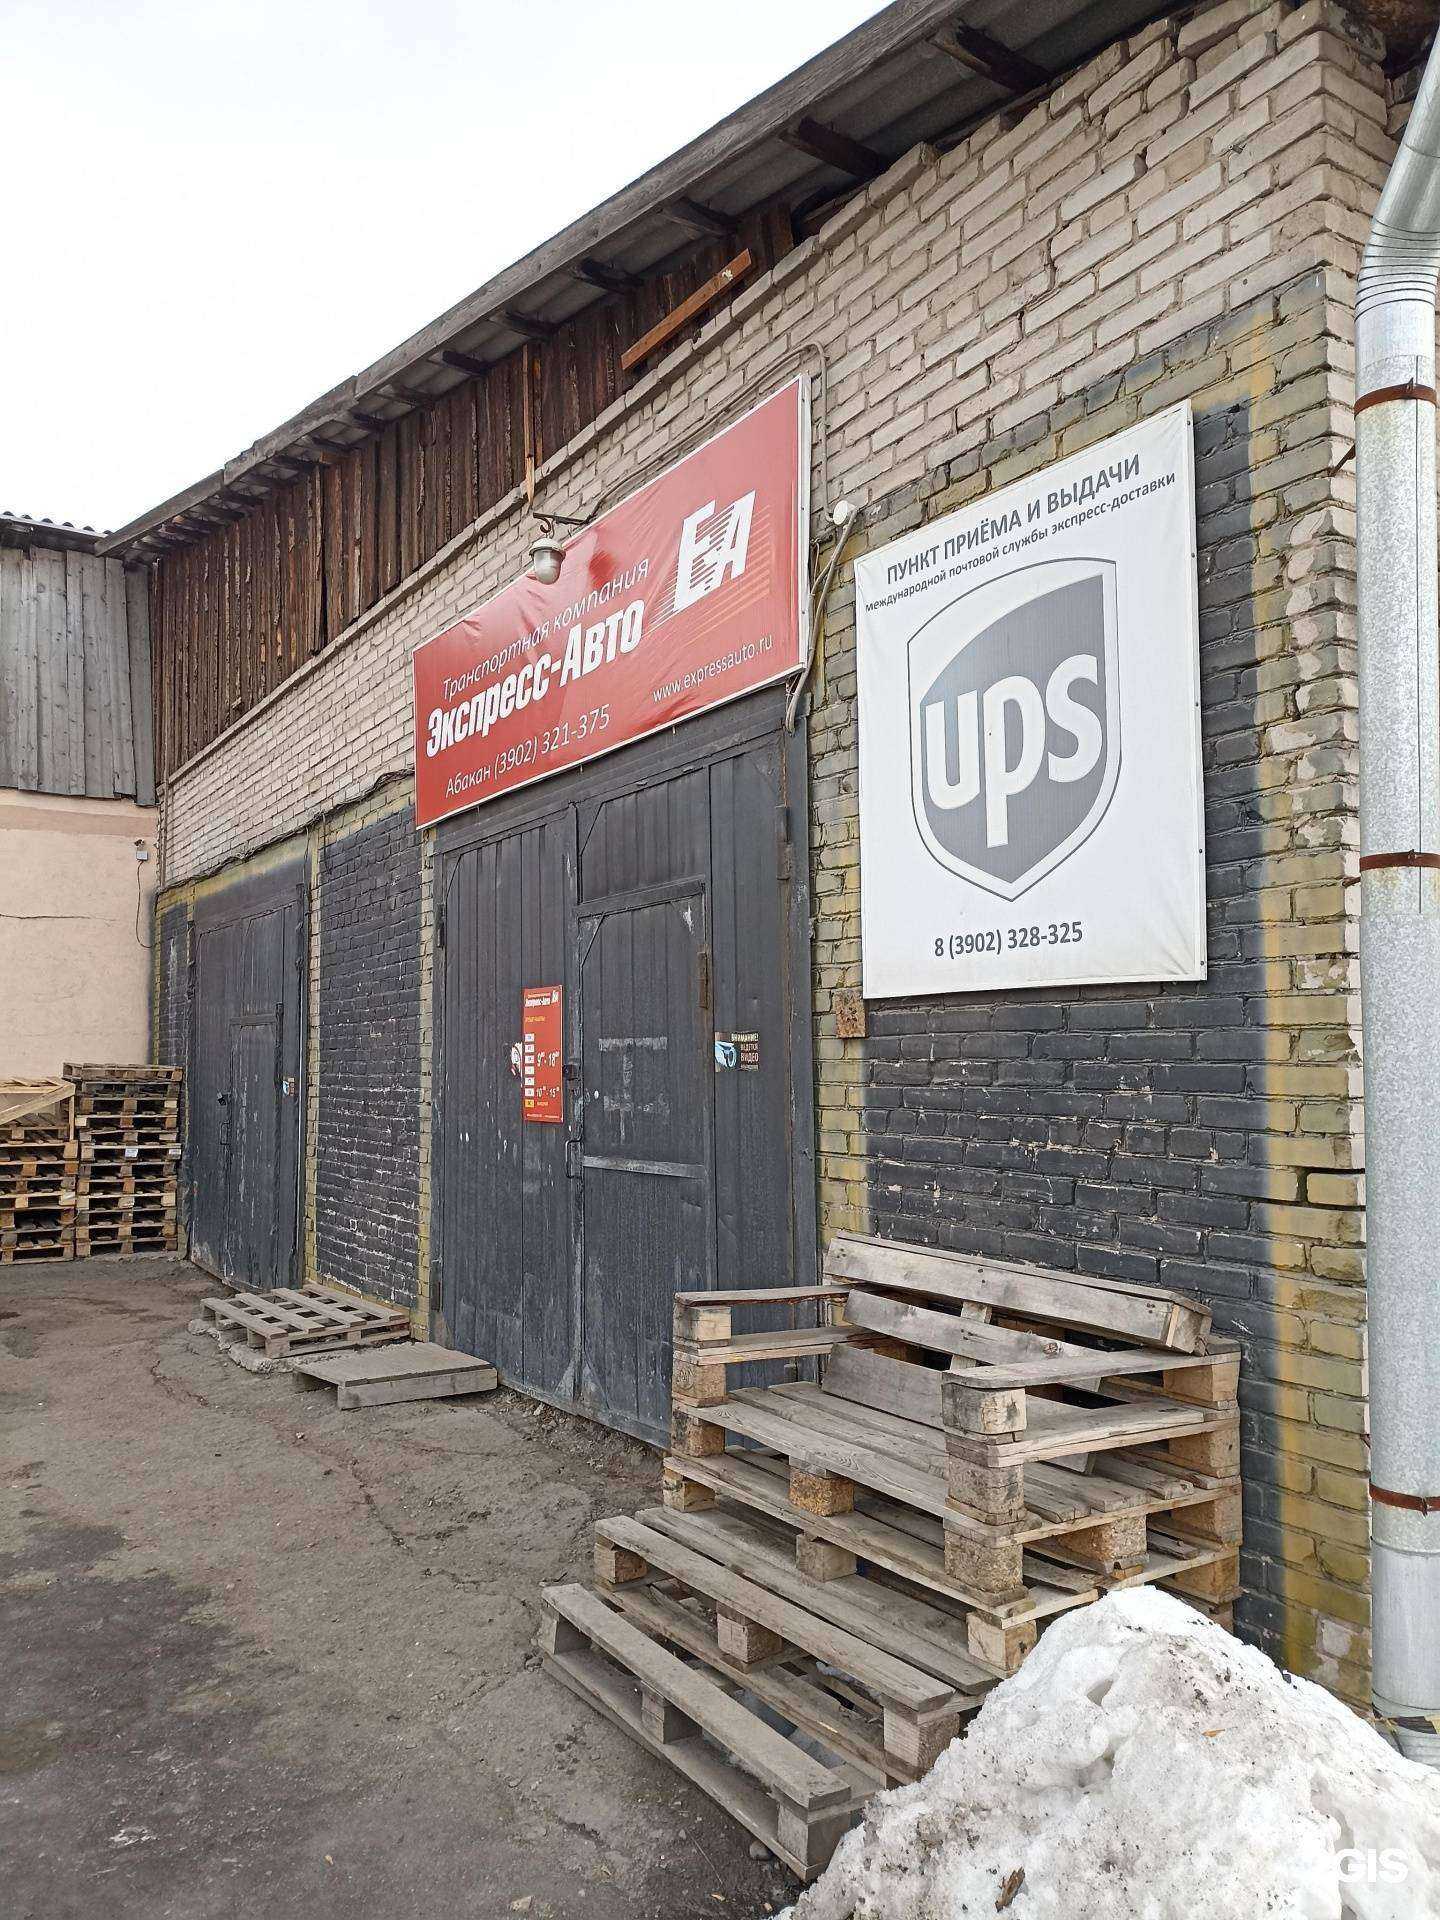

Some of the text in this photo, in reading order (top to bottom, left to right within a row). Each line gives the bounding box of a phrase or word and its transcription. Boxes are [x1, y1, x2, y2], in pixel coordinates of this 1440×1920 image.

[865, 473, 1176, 612] международной почтовой службы экспресс-доставки
[887, 454, 1140, 584] ПУНКТ ПРИЁМА И ВЫДАЧИ
[426, 599, 645, 758] Экспресс-Авто
[442, 558, 649, 702] Транспортная компания
[652, 636, 773, 702] www.expressauto.ru
[445, 704, 611, 798] Абакан (3902) 321-375
[934, 921, 1083, 959] 8 (3902) 328-325
[740, 1052, 758, 1063] ВИДЕО
